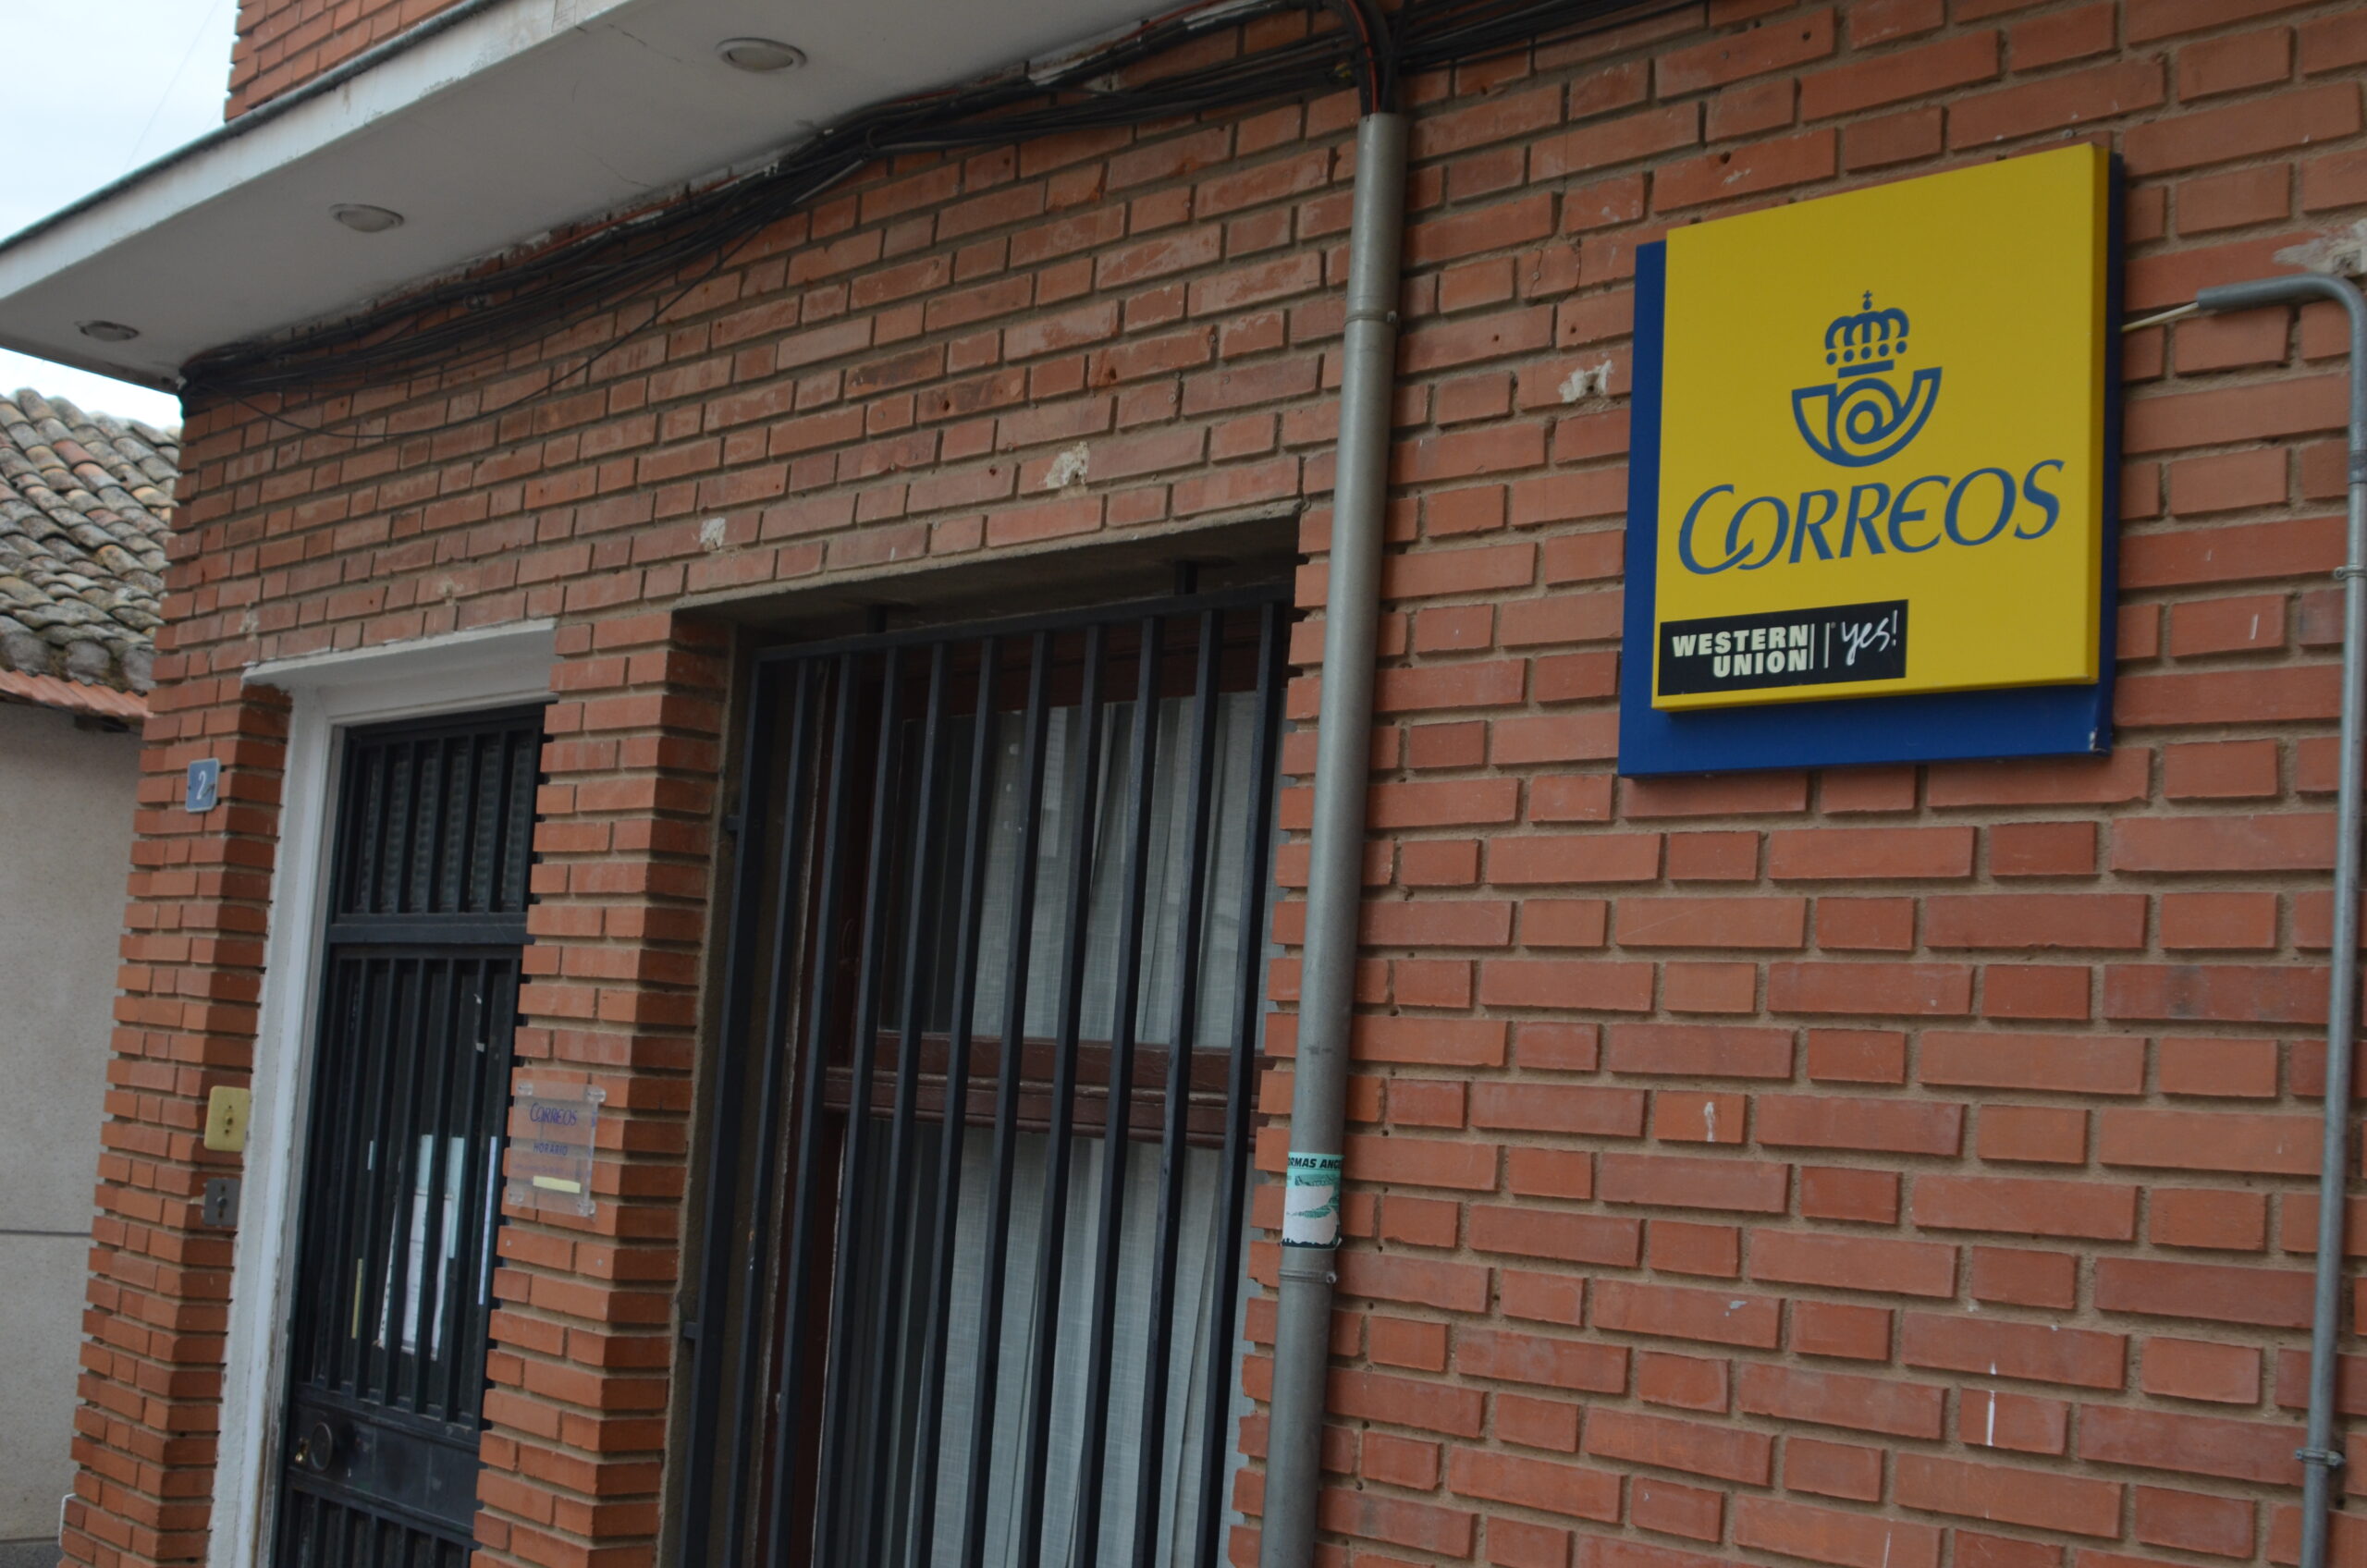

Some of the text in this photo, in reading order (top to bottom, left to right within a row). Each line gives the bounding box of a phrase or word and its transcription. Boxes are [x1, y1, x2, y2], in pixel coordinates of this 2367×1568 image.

[1678, 459, 2066, 575] CORREOS
[1673, 624, 1809, 657] WESTERN
[1841, 609, 1898, 667] yes!
[1713, 649, 1808, 678] UNION
[196, 770, 210, 801] 2
[530, 1102, 577, 1125] CORREOS
[533, 1142, 569, 1156] HORARIO
